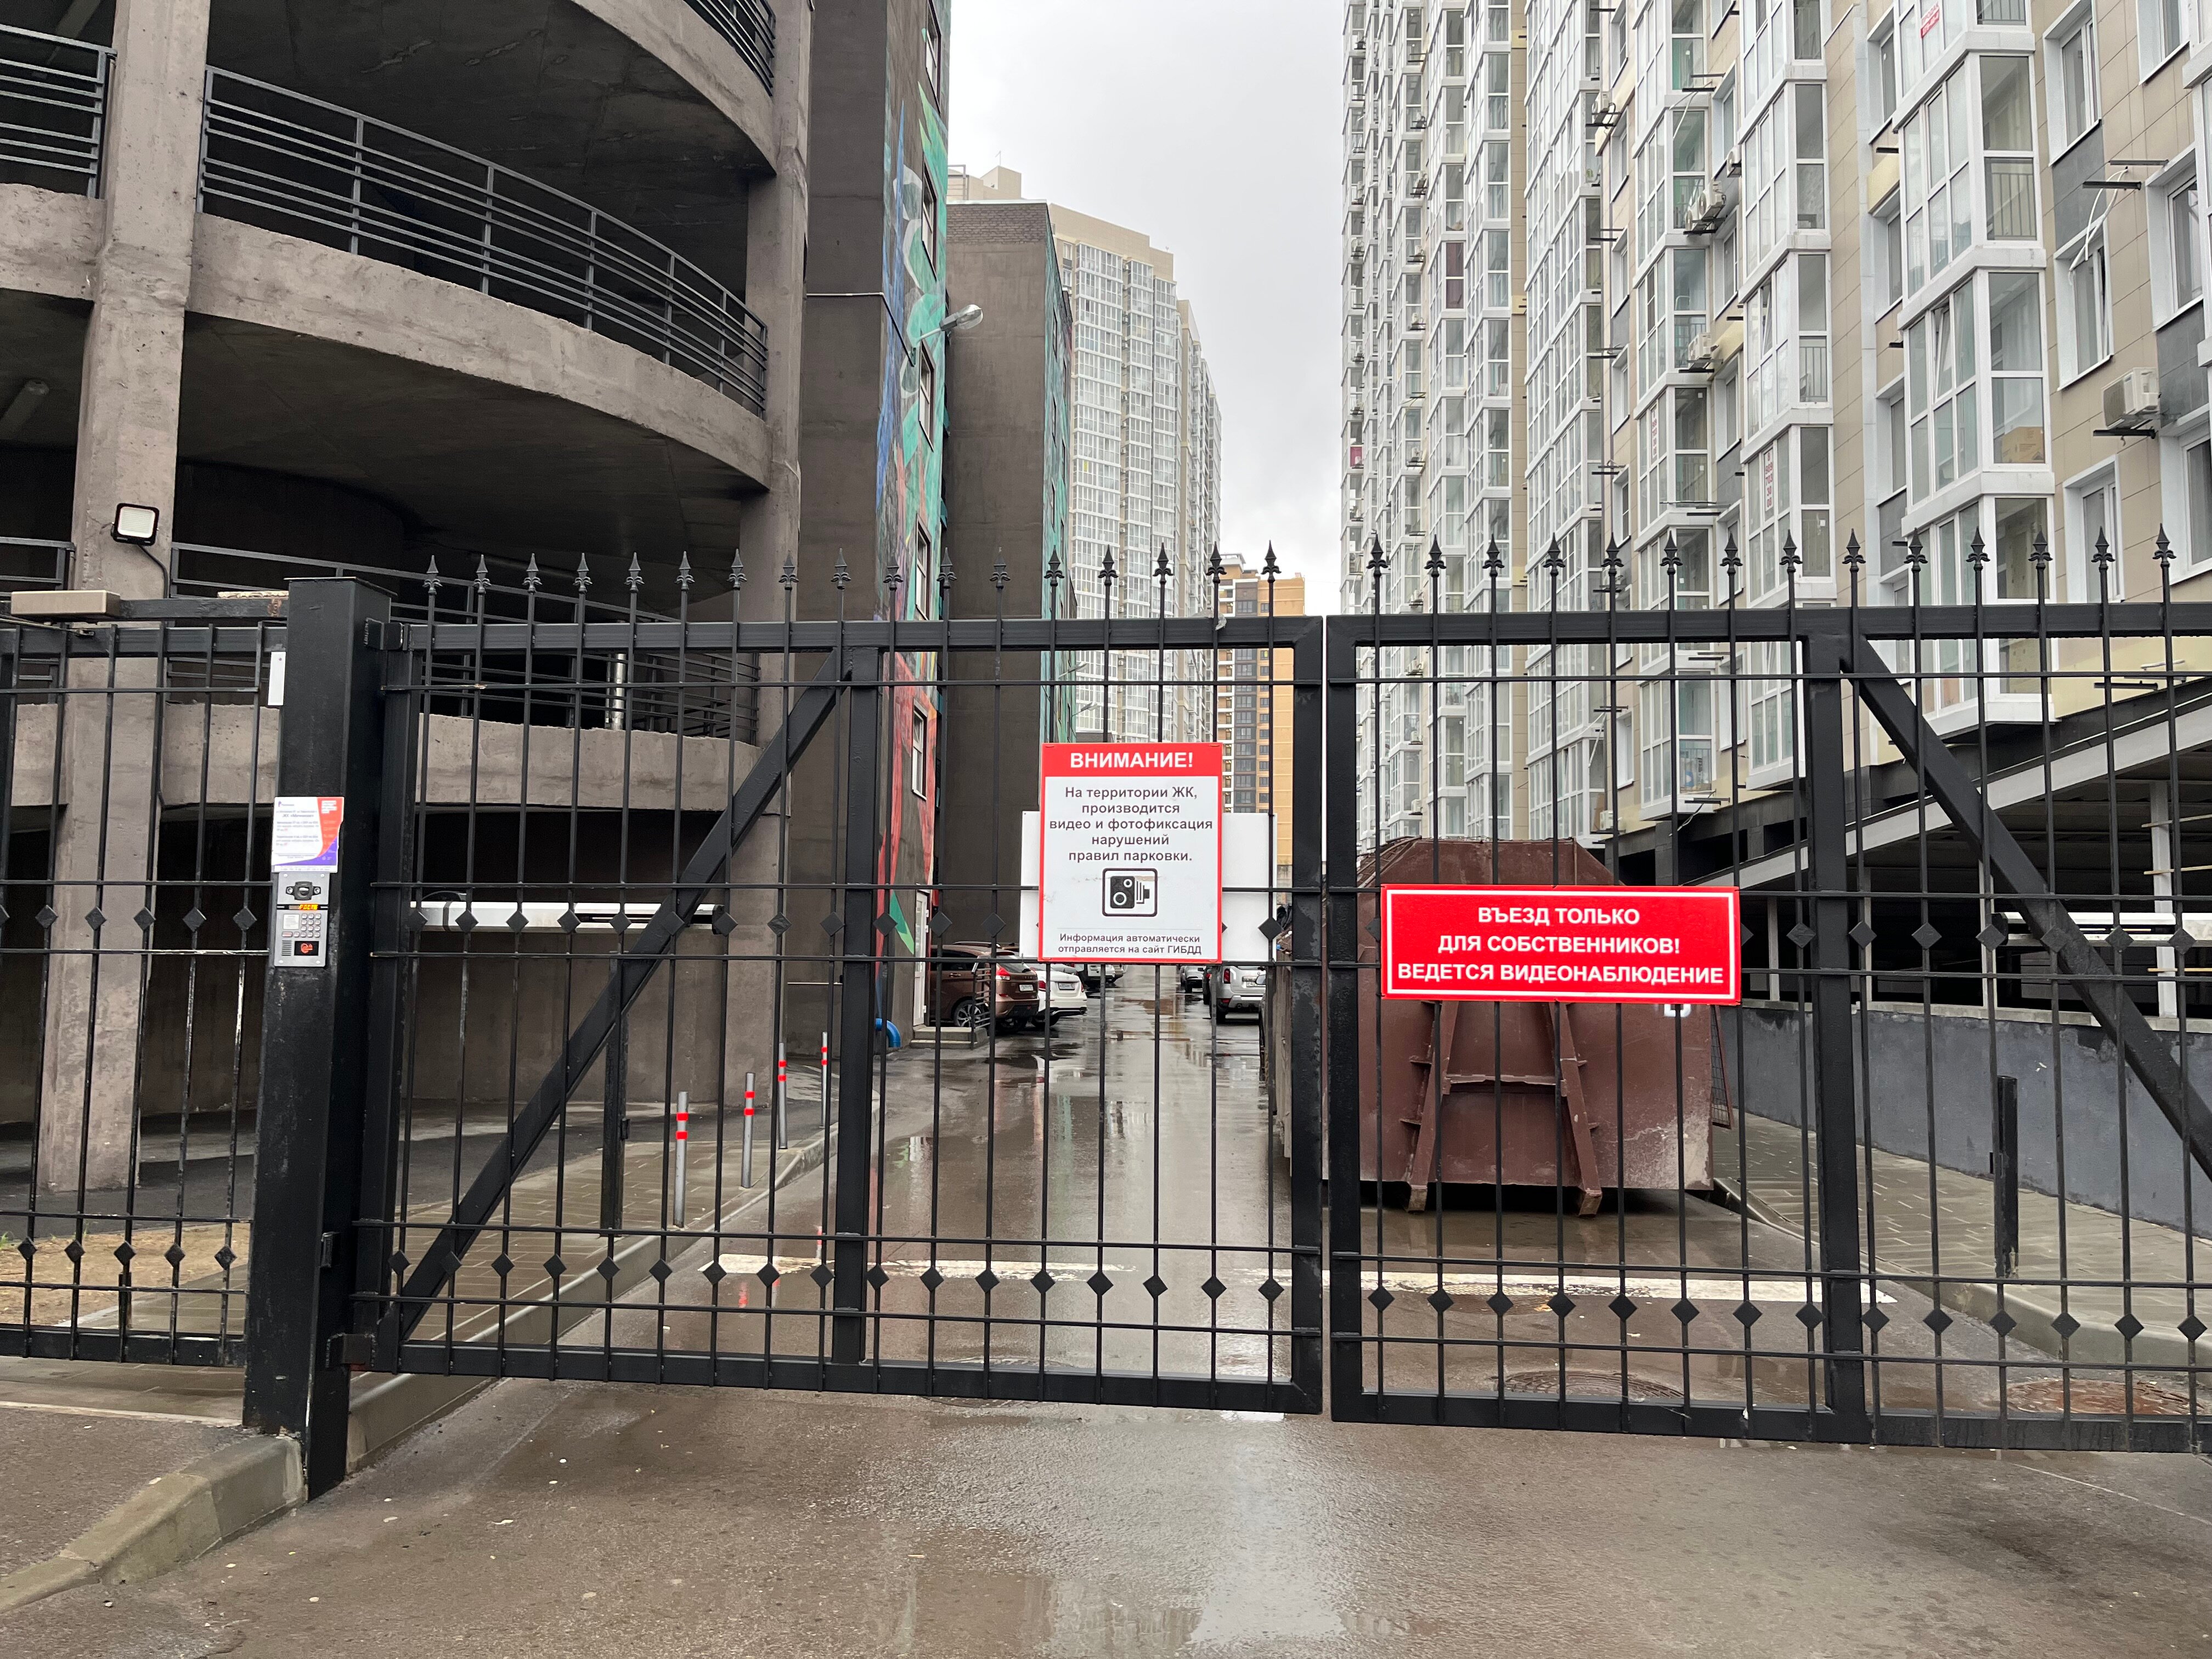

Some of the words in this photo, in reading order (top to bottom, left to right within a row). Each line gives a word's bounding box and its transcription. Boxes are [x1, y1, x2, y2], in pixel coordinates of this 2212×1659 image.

[1070, 752, 1193, 768] ВНИМАНИЕ!
[1065, 786, 1082, 797] На
[1086, 789, 1168, 800] территории
[1172, 786, 1197, 798] ЖК,
[1082, 804, 1180, 815] производится
[1049, 820, 1091, 830] видео
[1096, 820, 1103, 828] и
[1108, 817, 1212, 831] фотофиксация
[1092, 833, 1169, 847] нарушений
[1069, 852, 1119, 862] правил
[1124, 852, 1192, 863] парковки.
[1479, 906, 1550, 926] ВЪЕЗД
[1554, 907, 1640, 924] ТОЛЬКО
[1060, 933, 1123, 943] Информация
[1438, 935, 1481, 953] ДЛЯ
[1487, 935, 1679, 953] СОБСТВЕННИКОВ!
[1167, 945, 1201, 955] ГИБДД
[1398, 963, 1494, 981] ВЕДЕТСЯ
[1500, 964, 1723, 985] ВИДЕОНАБЛЮДЕНИЕ
